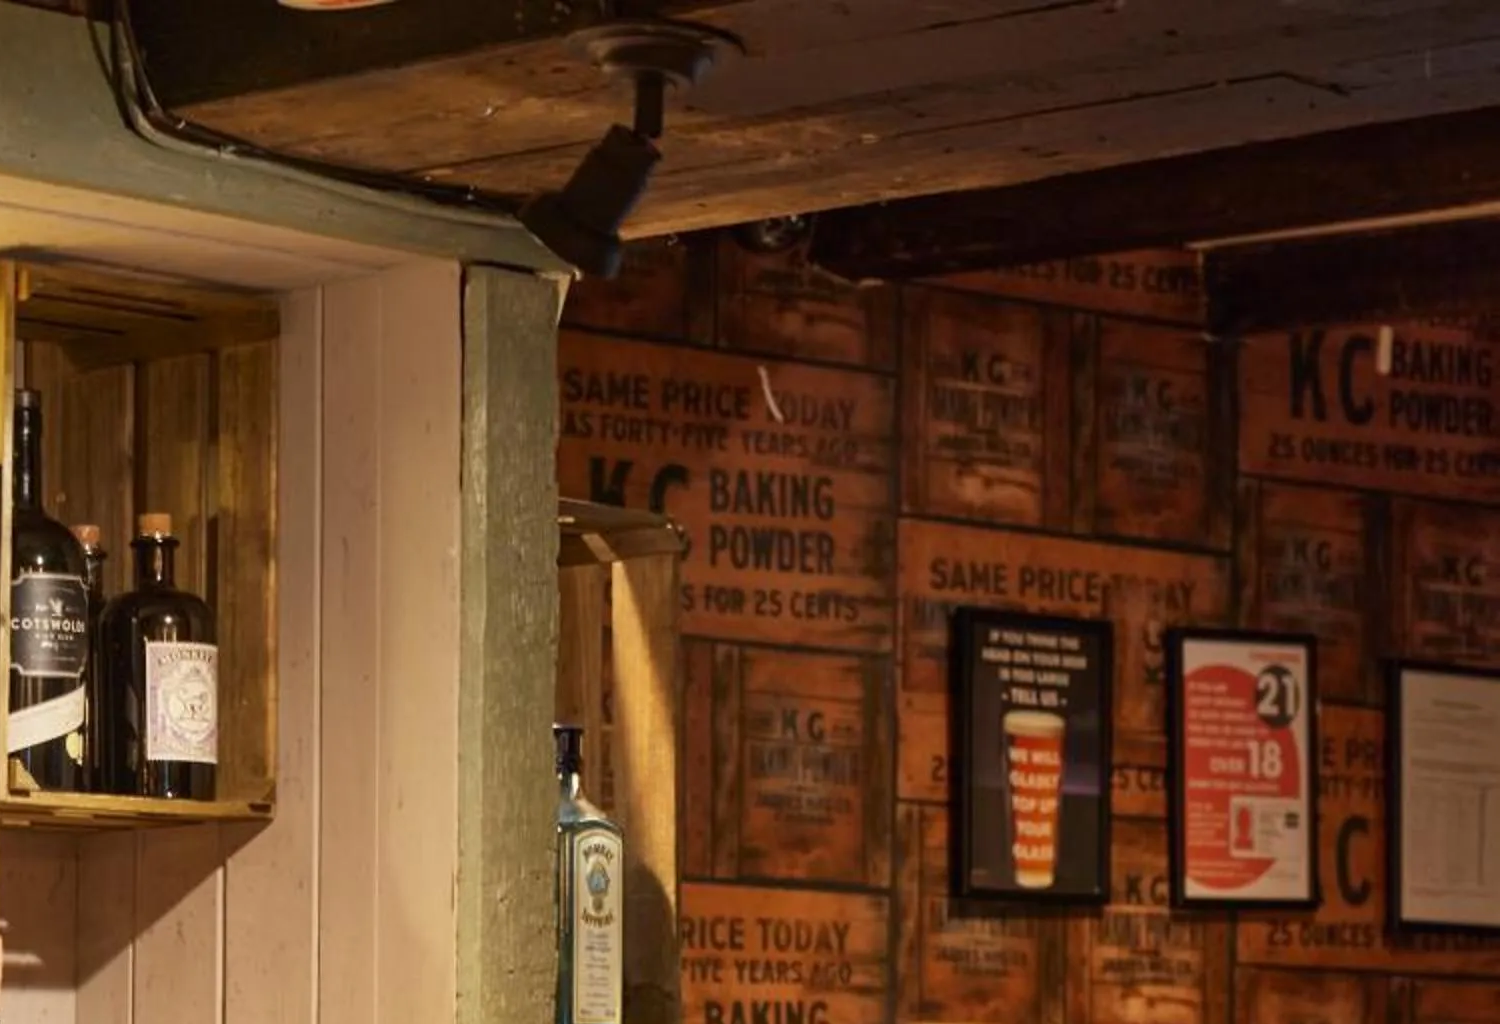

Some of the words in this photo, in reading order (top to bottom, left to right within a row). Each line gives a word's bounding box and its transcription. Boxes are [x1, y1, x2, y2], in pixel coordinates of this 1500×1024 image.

[563, 369, 650, 409] SAME
[661, 378, 751, 420] PRICE
[709, 467, 836, 522] BAKING
[709, 523, 836, 576] POWDER
[928, 556, 1009, 597] SAME
[1017, 562, 1103, 604] PRICE
[703, 585, 746, 614] FOR
[753, 589, 783, 618] 25
[789, 592, 861, 624] CENTS
[1257, 672, 1297, 716] 21
[1248, 739, 1283, 780] 18
[682, 916, 746, 951] RICE
[759, 917, 849, 953] TODAY
[735, 959, 803, 985] YEARS
